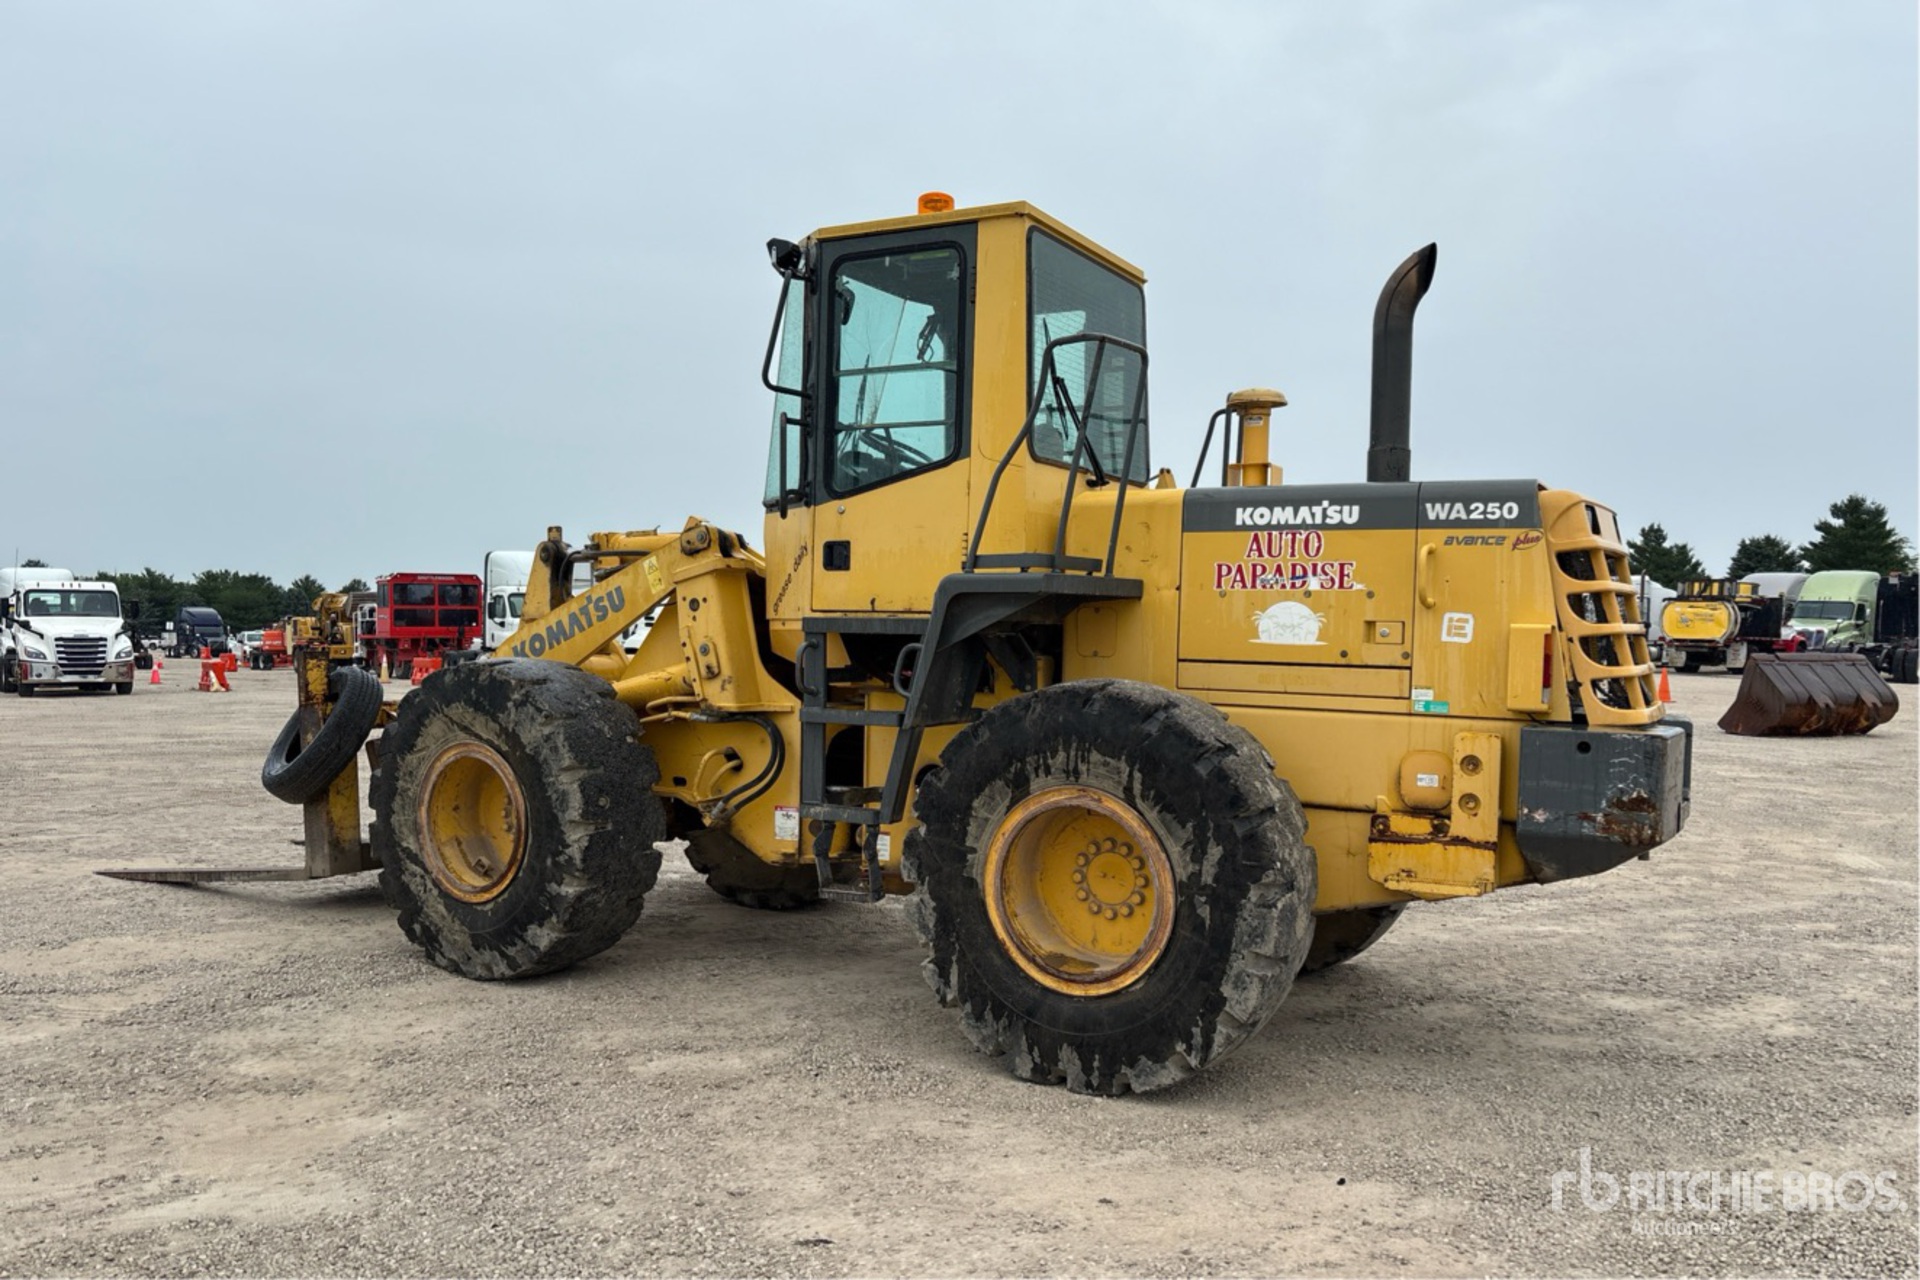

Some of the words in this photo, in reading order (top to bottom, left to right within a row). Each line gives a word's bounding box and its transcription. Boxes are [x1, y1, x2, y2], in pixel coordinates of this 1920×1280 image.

[1235, 500, 1360, 526] KOMATSU
[1425, 502, 1519, 521] WA250
[1245, 530, 1324, 559] AUTO
[1443, 535, 1508, 546] avance
[1214, 561, 1357, 591] PARADISE
[511, 585, 625, 658] KOMATSU
